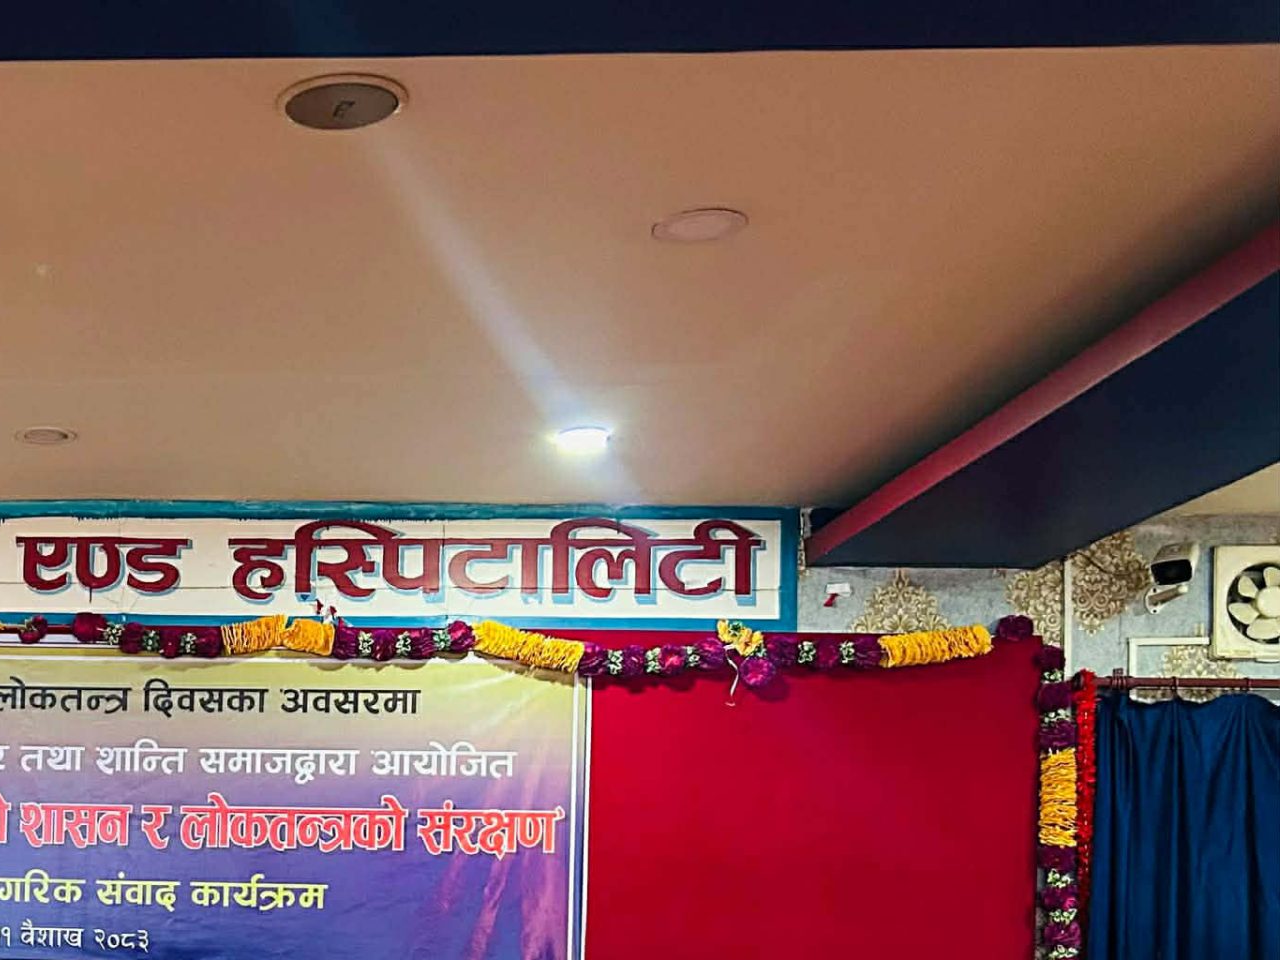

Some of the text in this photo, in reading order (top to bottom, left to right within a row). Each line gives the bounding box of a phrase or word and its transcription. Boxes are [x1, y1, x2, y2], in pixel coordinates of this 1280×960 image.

[16, 535, 191, 597] एण्ड
[228, 518, 767, 602] हस्पिटालिटी
[143, 678, 269, 717] दिवसका
[279, 687, 421, 715] अवसरमा
[20, 745, 86, 772] तथा
[96, 738, 187, 776] शान्ति
[199, 748, 360, 784] समाजद्वारा
[370, 741, 518, 780] आयोजित
[19, 801, 133, 848] शासन
[141, 803, 172, 850] र
[179, 791, 409, 853] लोकतन्त्रको
[95, 871, 181, 912] संवाद
[190, 873, 329, 911] कार्यक्रम
[20, 918, 85, 948] वैशाख
[93, 928, 150, 953] २०८३
